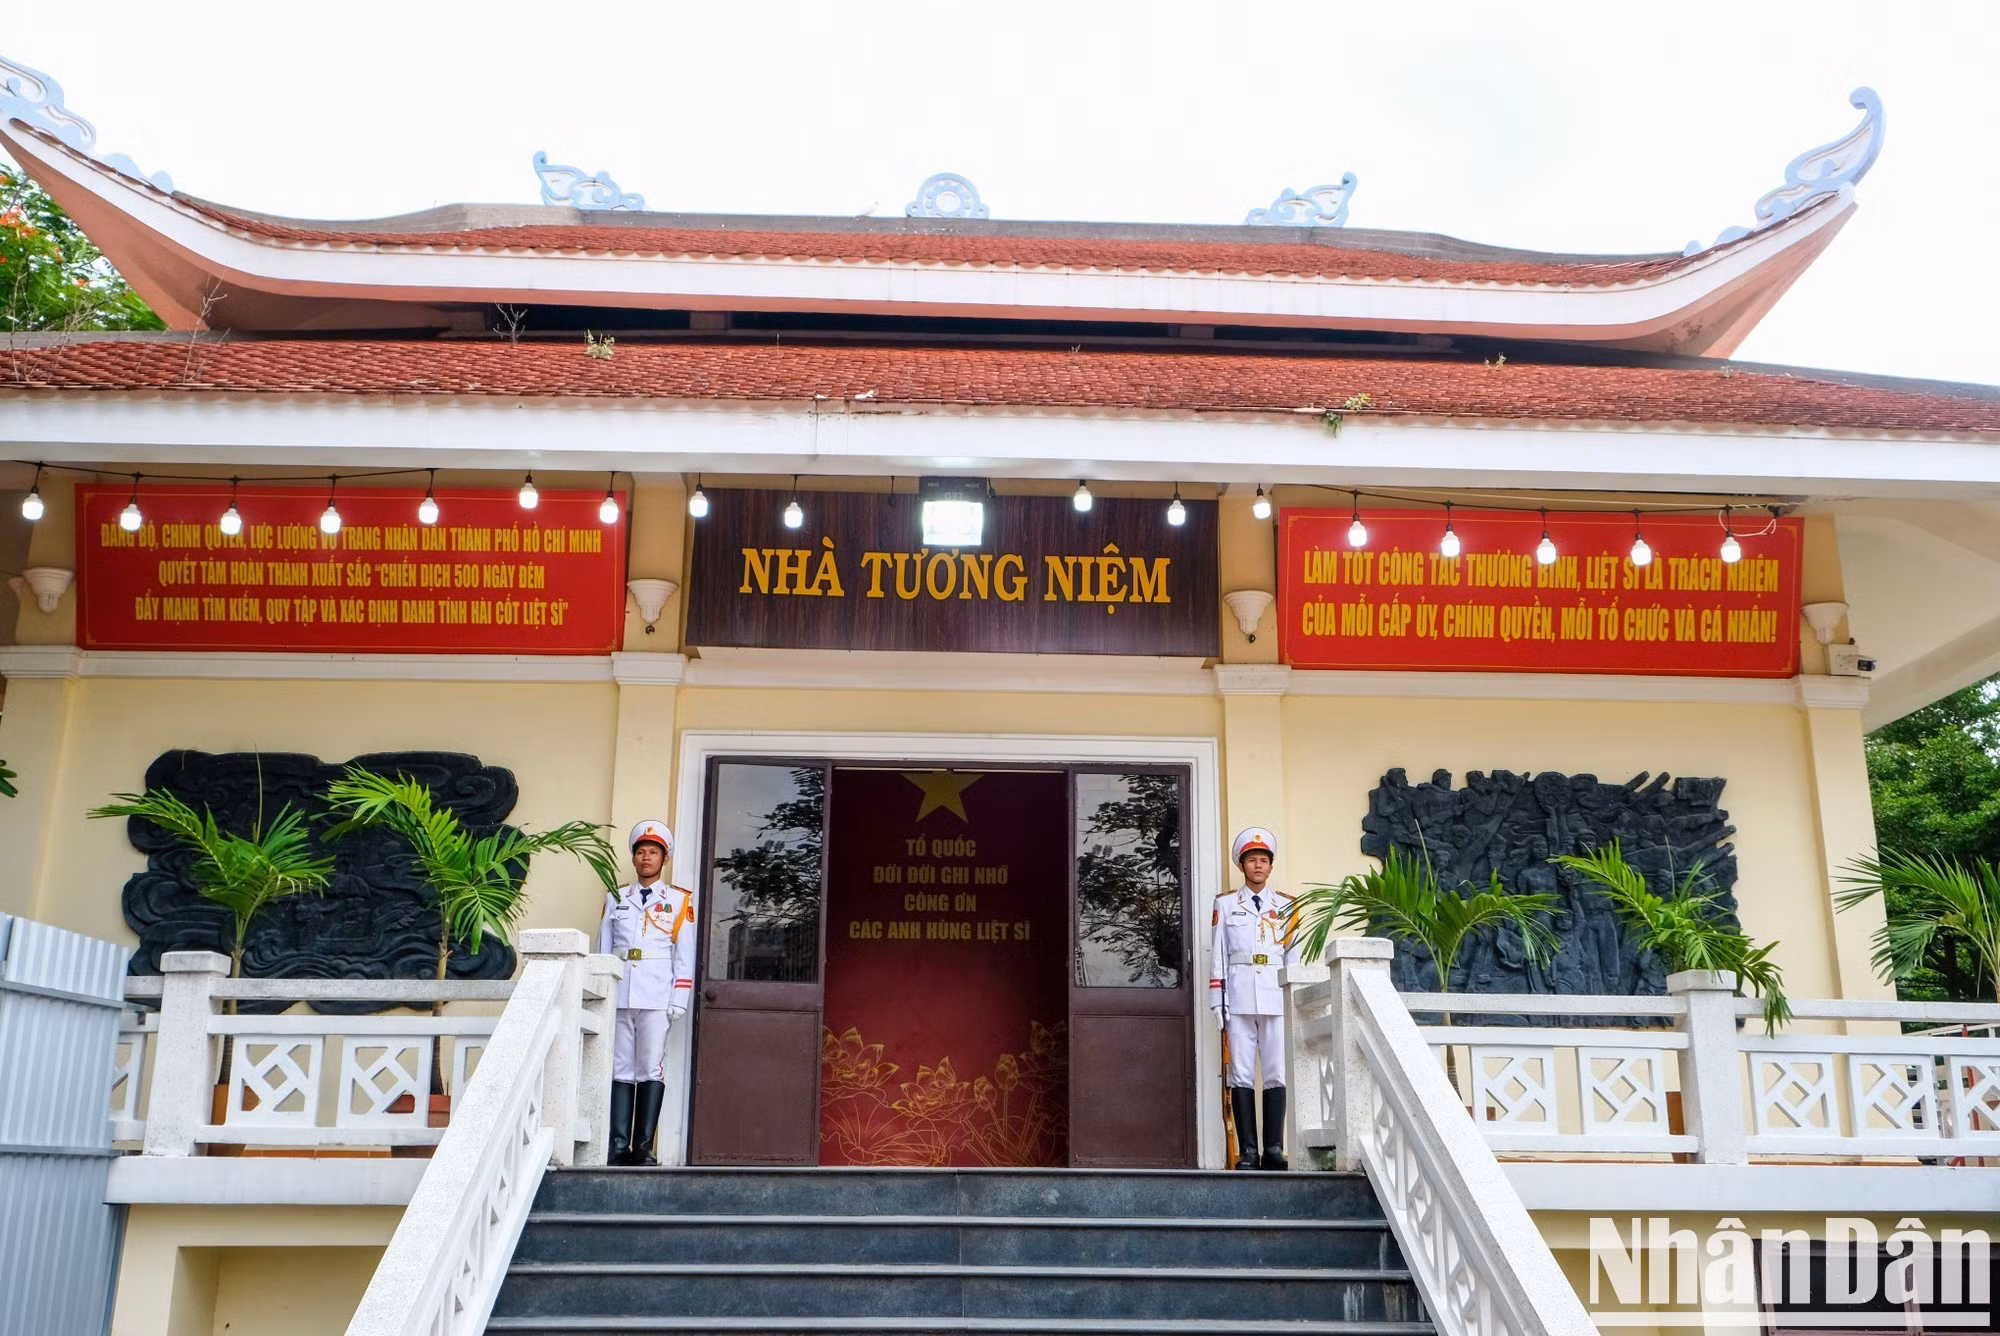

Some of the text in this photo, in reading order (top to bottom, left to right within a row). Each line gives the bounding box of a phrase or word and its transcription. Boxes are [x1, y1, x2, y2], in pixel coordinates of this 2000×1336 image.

[162, 520, 201, 548] CHÍNH
[250, 522, 273, 553] LỰC
[277, 522, 317, 554] LƯỢNG
[342, 527, 381, 551] TRANG
[385, 523, 418, 551] NHÂN
[422, 524, 446, 551] DÂN
[450, 524, 491, 552] THÀNH
[495, 521, 520, 552] PHỐ
[523, 521, 540, 553] HỒ
[543, 526, 565, 553] CHÍ
[569, 529, 601, 553] MINH
[159, 553, 196, 587] QUYẾT
[200, 557, 226, 585] TÂM
[231, 558, 264, 586] HOÀN
[267, 558, 308, 586] THÀNH
[312, 555, 342, 586] XUẤT
[347, 556, 371, 587] SẮC
[421, 563, 450, 592] DỊCH
[455, 564, 479, 588] 500
[483, 561, 515, 589] NGÀY
[519, 561, 545, 589] ĐÊM
[739, 536, 845, 597] NHÀ
[1043, 542, 1172, 615] NIỆM
[1304, 546, 1338, 585] LÀM
[1378, 546, 1424, 586] CÔNG
[1466, 549, 1532, 588] THƯƠNG
[1586, 551, 1619, 595] LIỆT
[1645, 552, 1663, 591] LÀ
[1668, 553, 1722, 592] TRÁCH
[1727, 554, 1779, 598] NHIỆM
[135, 588, 159, 621] ĐẨY
[163, 597, 199, 625] MẠNH
[203, 594, 226, 621] TÌM
[230, 590, 262, 624] KIẾM,
[266, 598, 292, 625] QUY
[295, 595, 317, 627] TẬP
[321, 595, 337, 623] VÀ
[340, 596, 364, 623] XÁC
[368, 600, 397, 628] ĐỊNH
[402, 600, 435, 623] DANH
[439, 597, 467, 624] TÍNH
[471, 597, 491, 624] HÀI
[496, 593, 519, 625] CỐT
[524, 598, 547, 630] LIỆT
[1303, 593, 1777, 643] CỦA MỖI CẤP ỦY, CHÍNH QUYỀN, MỖI TỔ CHỨC VÀ CÁ NHÂN!
[906, 834, 977, 858] TỔ QUỐC
[941, 867, 969, 884] GHI
[904, 891, 977, 912] CÔNG ƠN
[849, 918, 883, 940] CÁC
[888, 921, 921, 940] ANH
[927, 919, 972, 940] HÙNG
[977, 920, 1009, 943] LIỆT
